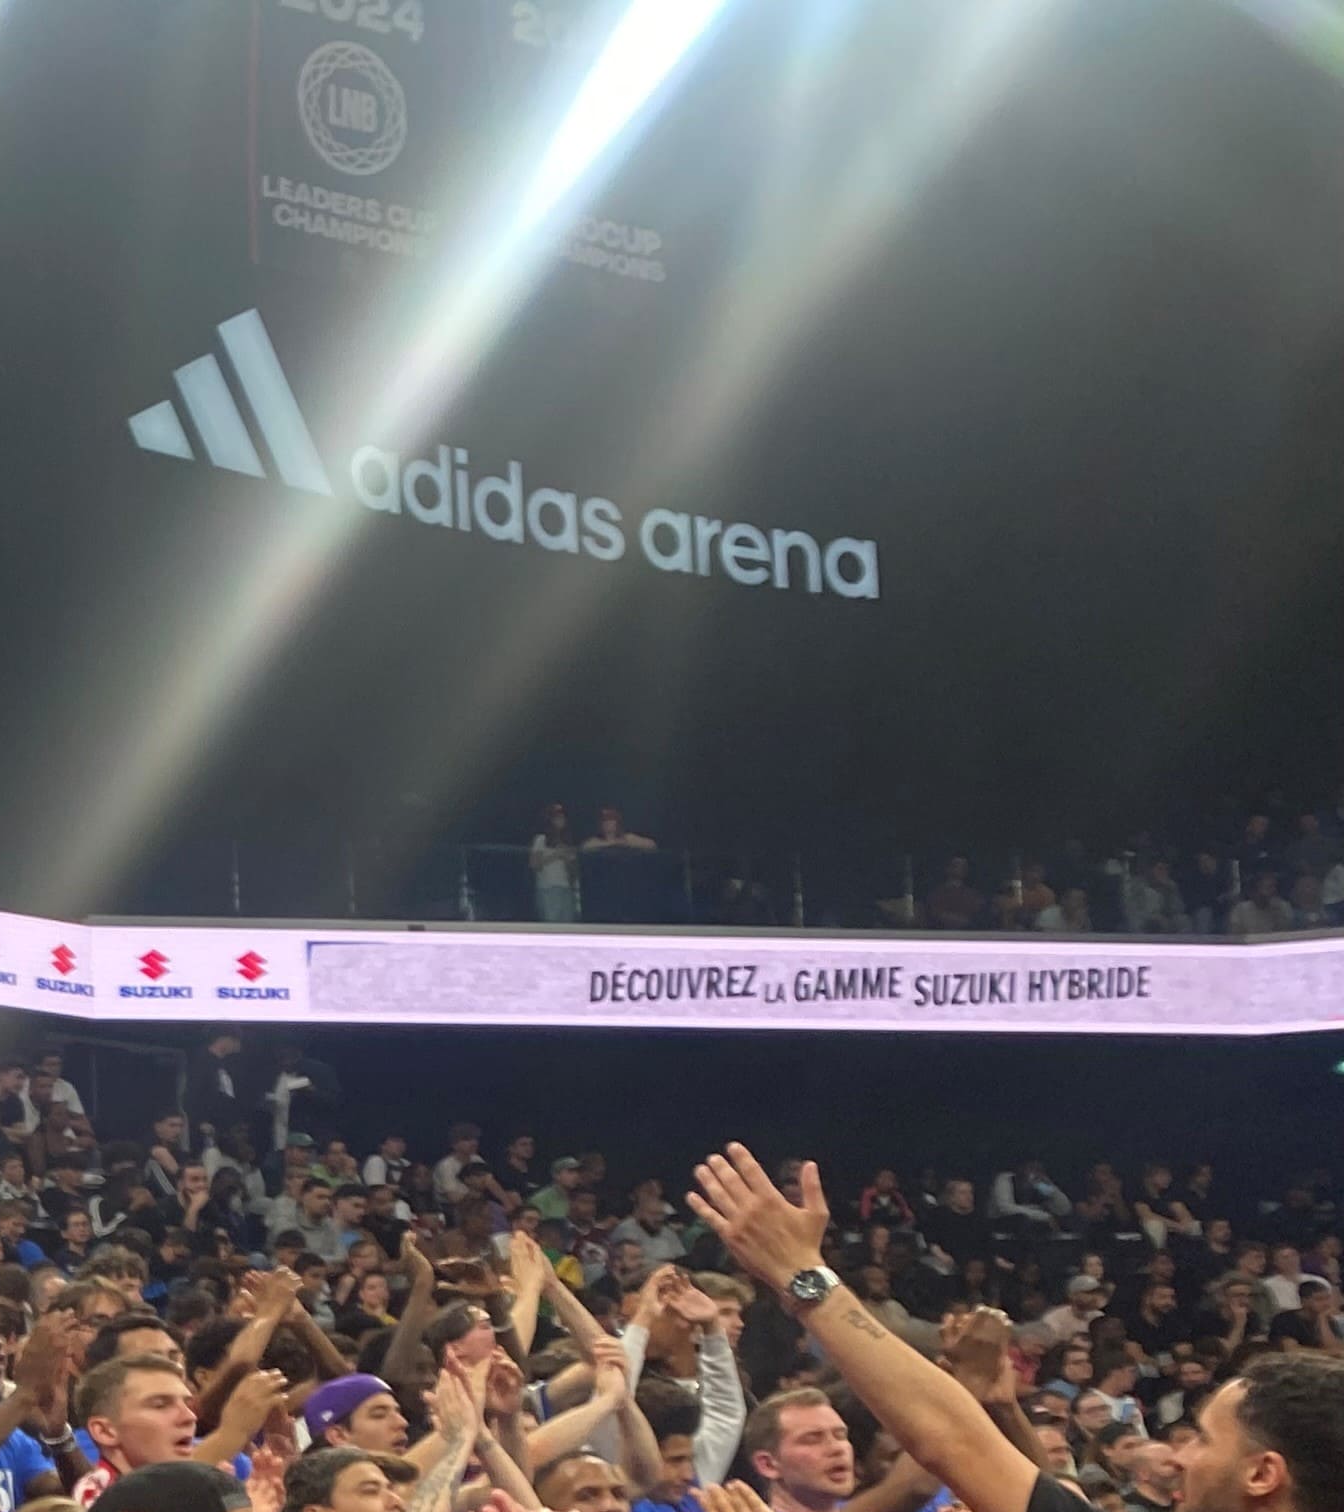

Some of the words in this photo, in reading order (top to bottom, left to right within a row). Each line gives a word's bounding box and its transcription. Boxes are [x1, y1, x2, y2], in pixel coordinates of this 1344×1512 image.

[328, 84, 378, 133] LNB
[261, 174, 382, 223] LEADERS
[350, 444, 625, 562] adidas
[640, 505, 881, 600] arena
[36, 976, 94, 997] SUZUKI
[119, 985, 192, 999] SUZUKI
[218, 986, 290, 1001] SUZUKI
[590, 962, 758, 1002] DÉCOUVREZ
[764, 983, 787, 1003] LA
[794, 966, 903, 1001] GAMME
[913, 971, 1017, 1007] SUZUKI
[1028, 965, 1152, 1001] HYBRIDE
